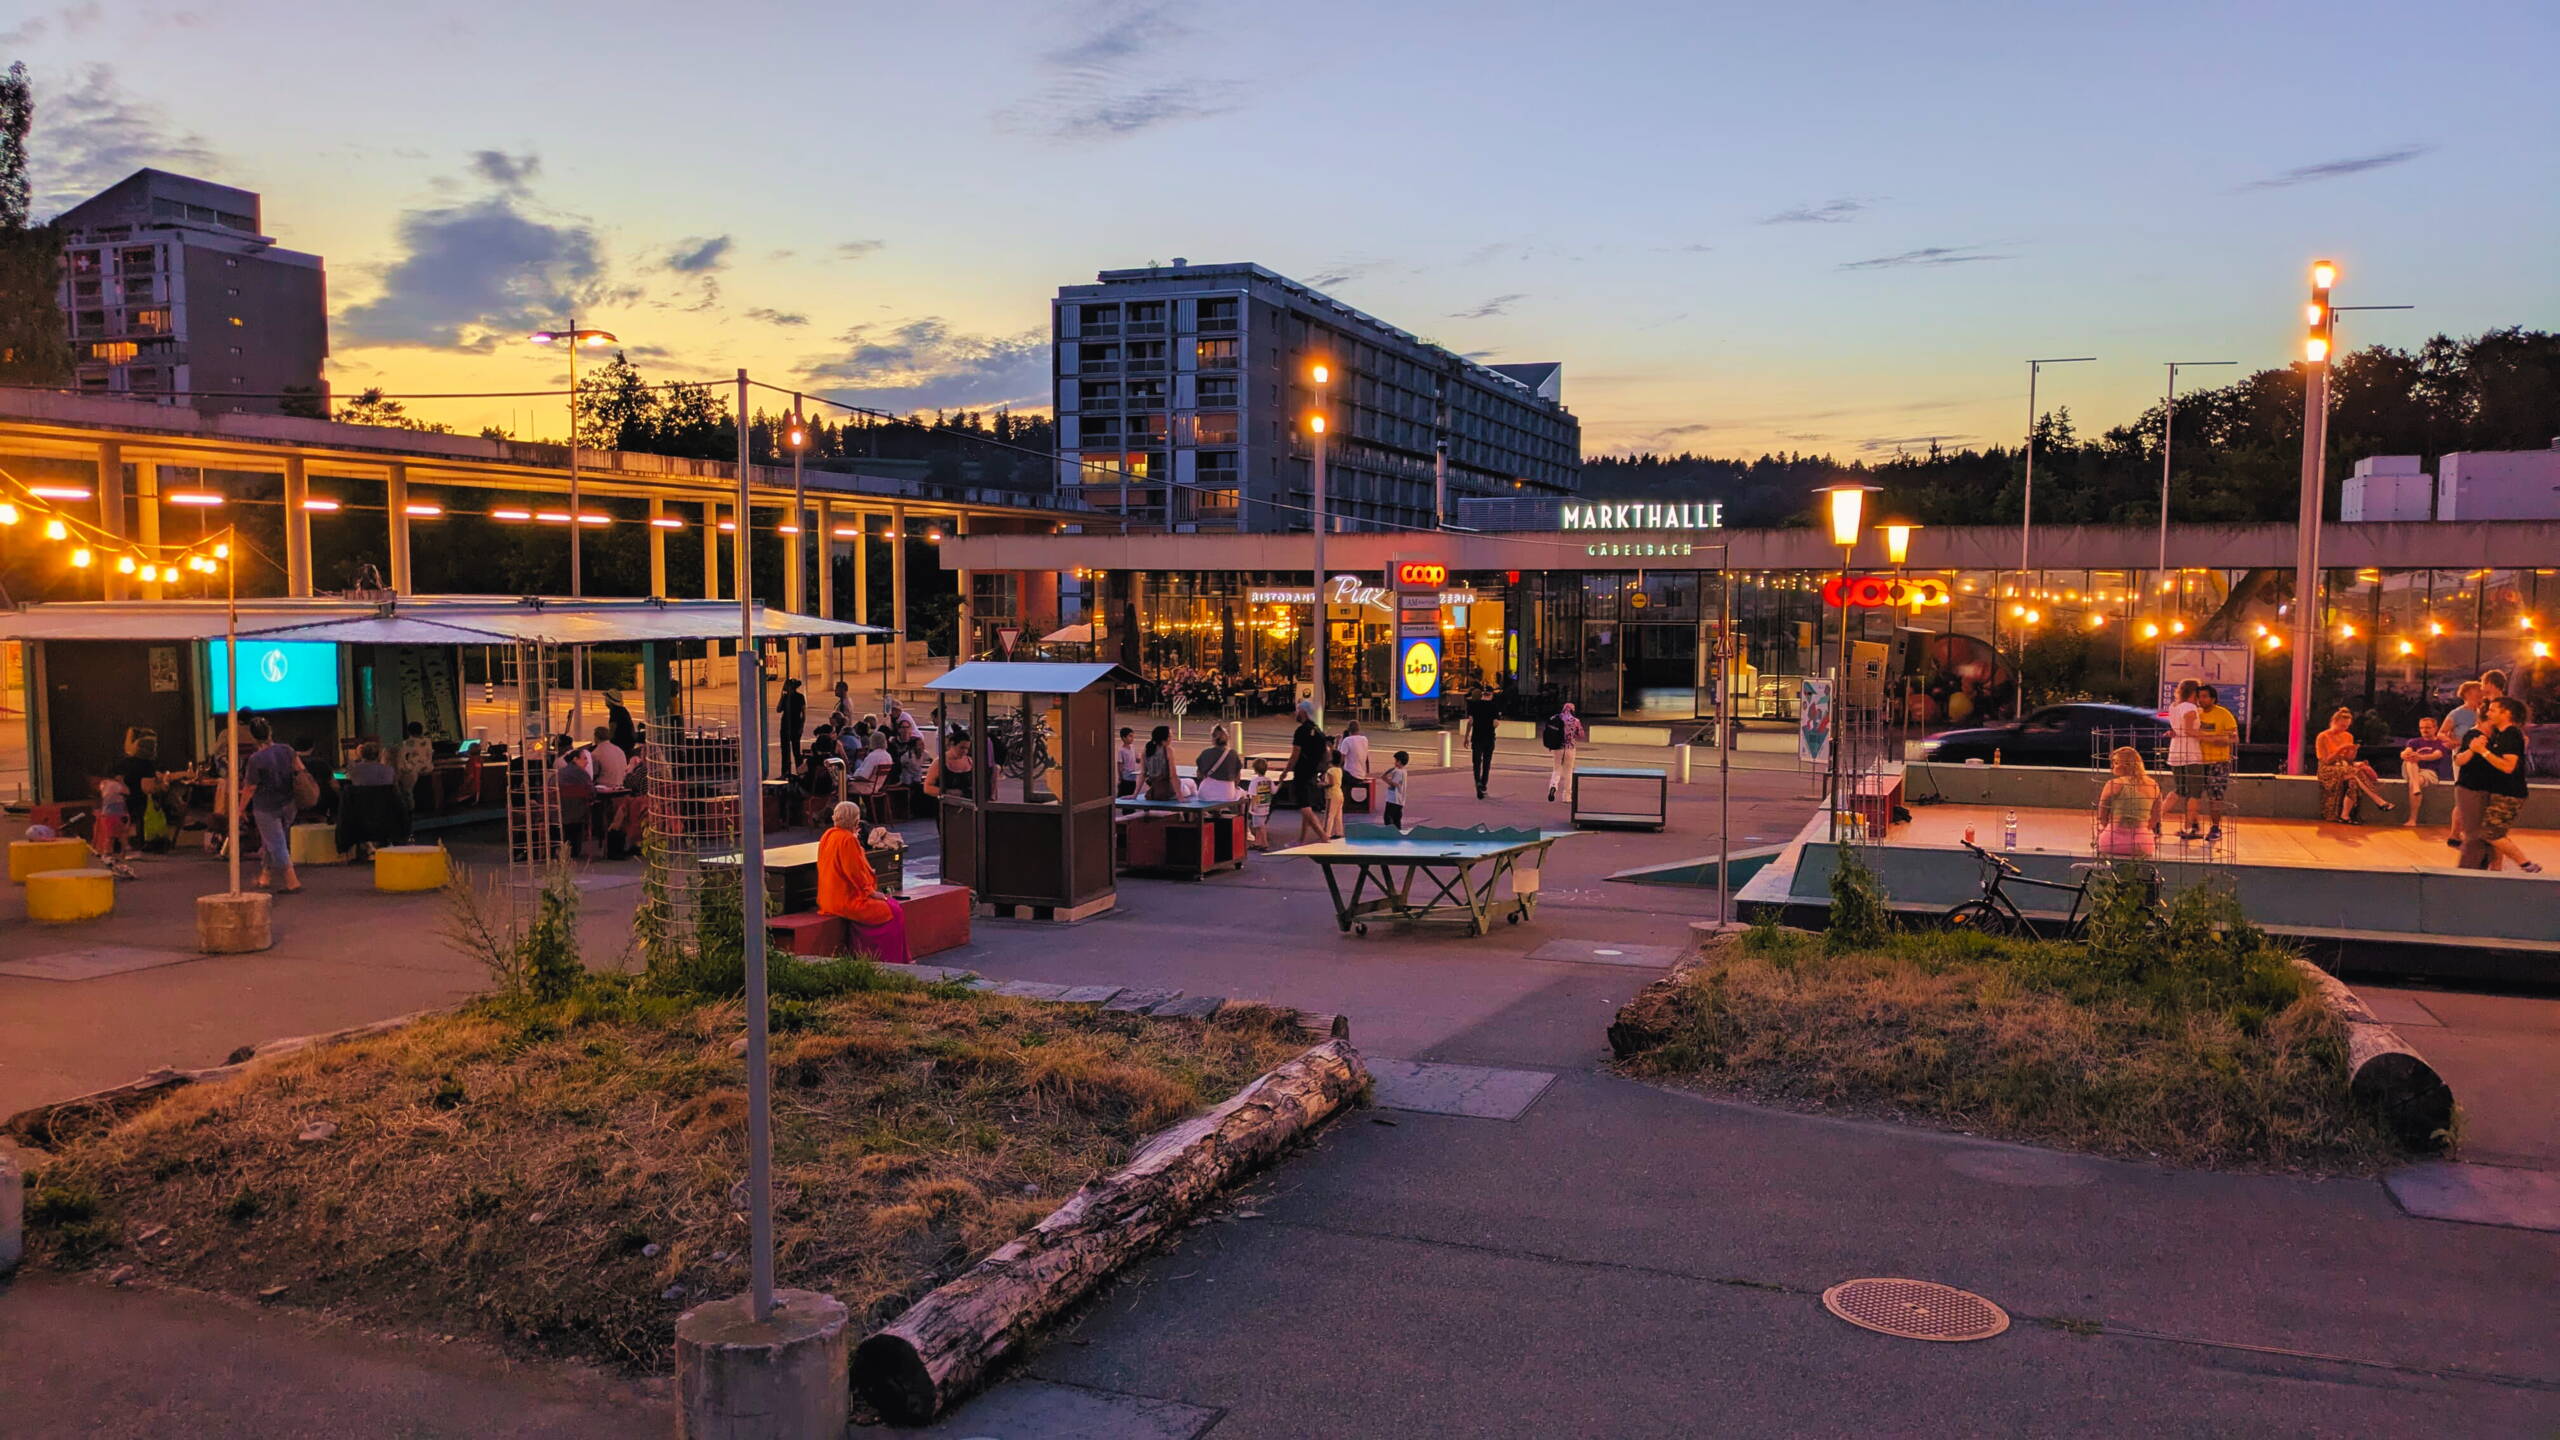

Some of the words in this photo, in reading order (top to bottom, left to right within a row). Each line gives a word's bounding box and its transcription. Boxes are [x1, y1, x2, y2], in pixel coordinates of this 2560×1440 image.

[1563, 503, 1723, 529] MARKTHALLE
[1400, 564, 1446, 588] coop
[1251, 592, 1316, 603] RISTORANT
[1439, 593, 1474, 604] ZERIA
[1823, 577, 1950, 615] coop
